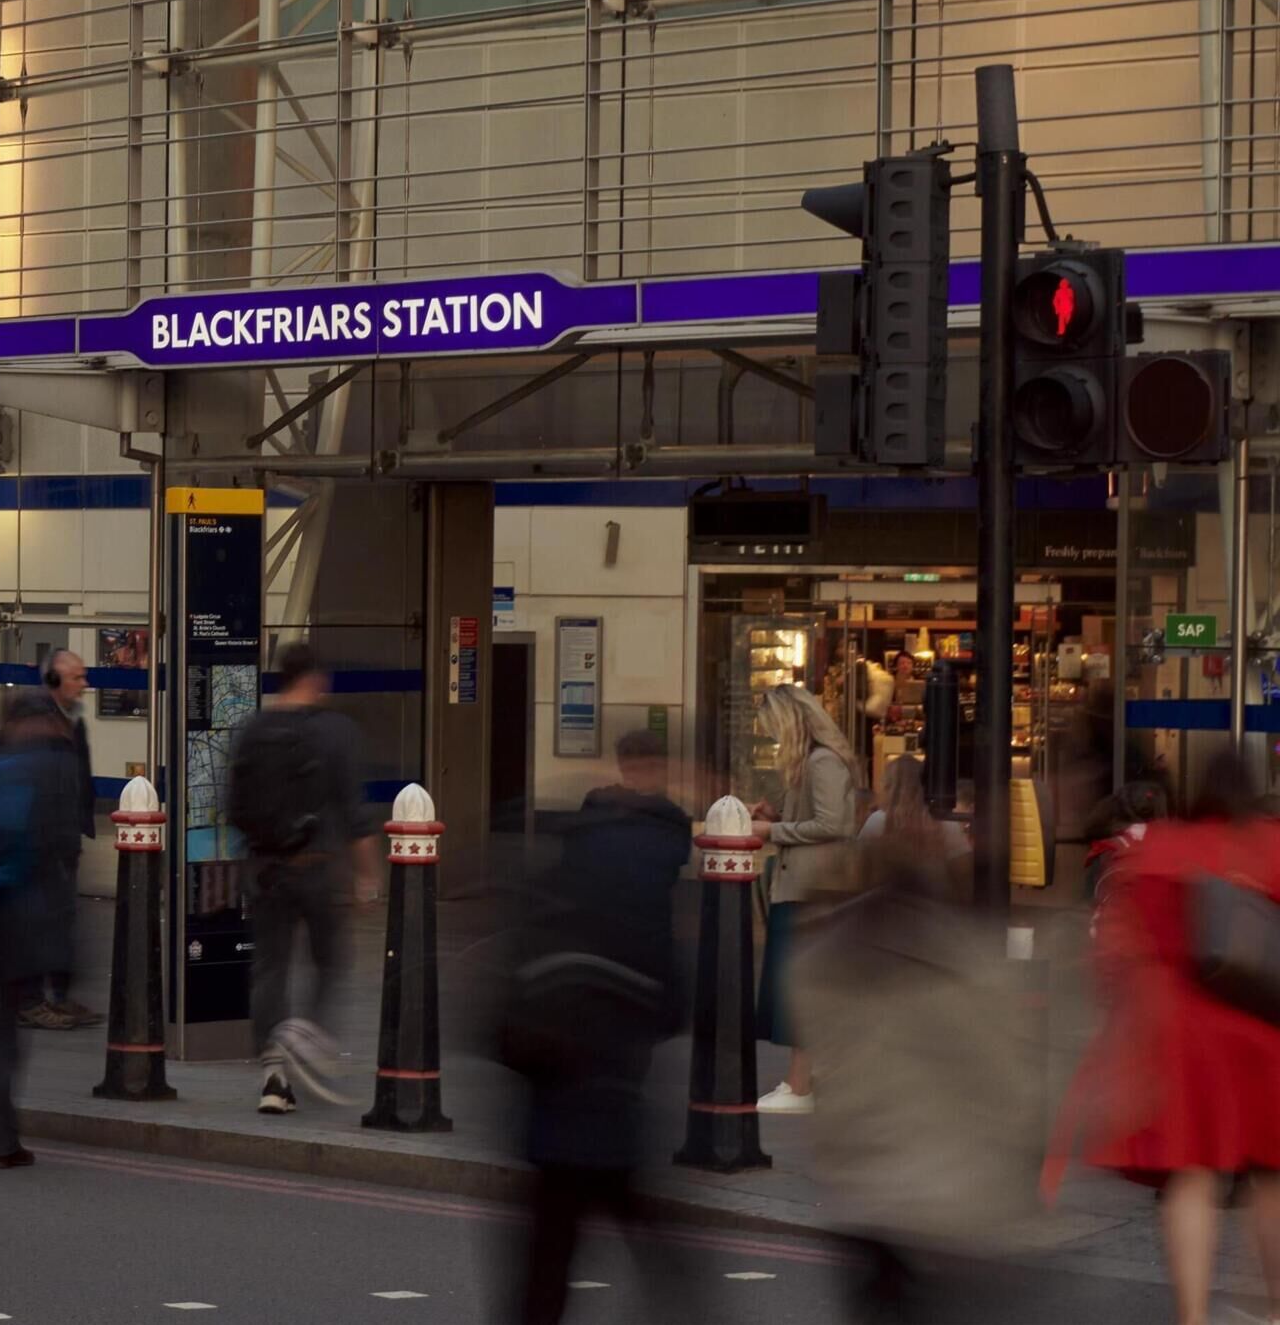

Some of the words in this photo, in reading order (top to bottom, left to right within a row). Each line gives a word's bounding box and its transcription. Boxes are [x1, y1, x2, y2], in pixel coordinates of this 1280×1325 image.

[151, 301, 372, 350] BLACKFRIARS
[381, 290, 543, 338] STATION
[1045, 545, 1080, 561] Freshly
[1177, 623, 1206, 637] SAP
